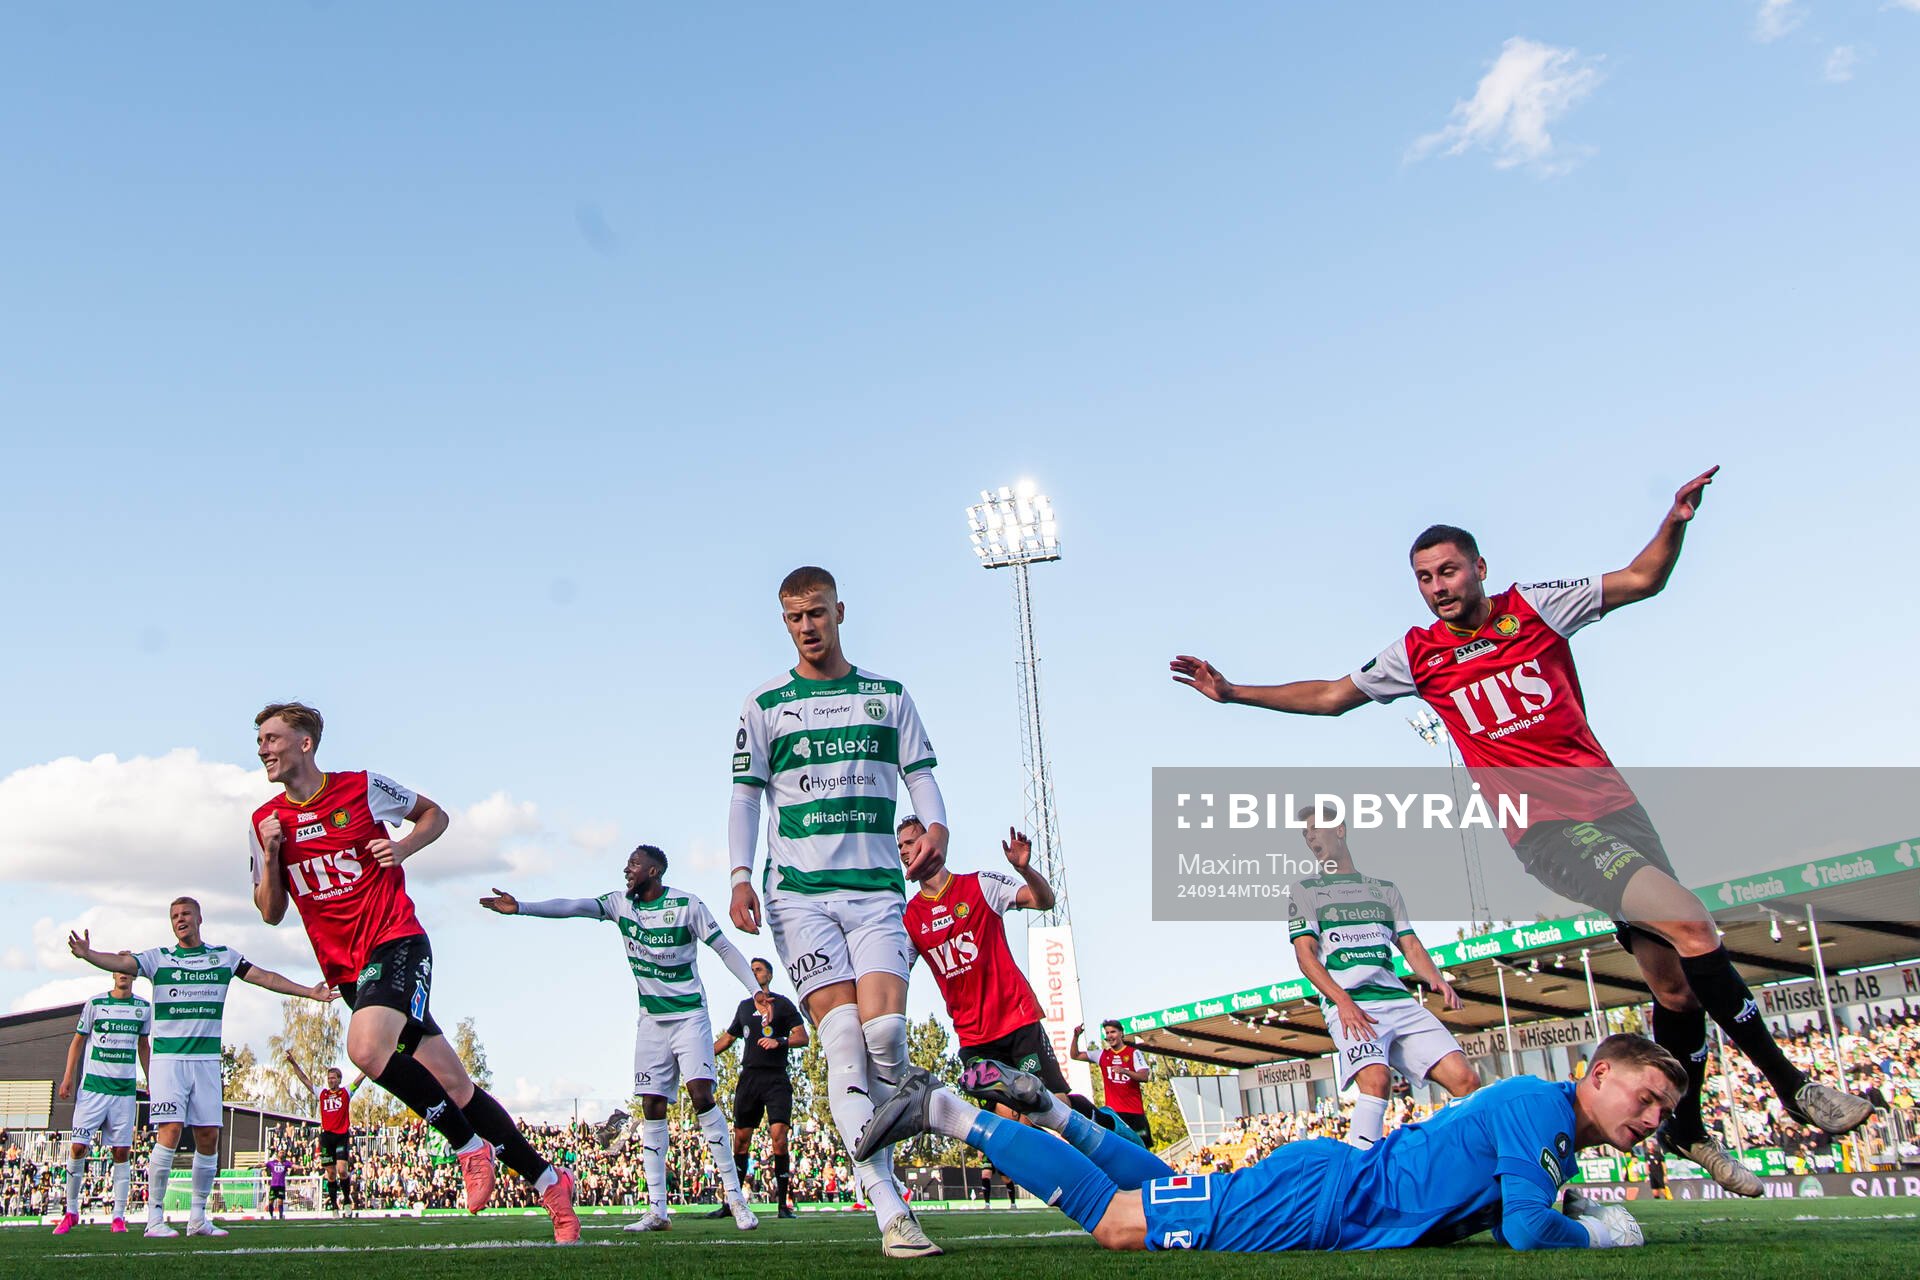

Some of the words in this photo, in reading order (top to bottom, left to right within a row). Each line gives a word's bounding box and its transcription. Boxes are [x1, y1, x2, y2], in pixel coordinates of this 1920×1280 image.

[1456, 638, 1491, 657] SKAB
[780, 690, 797, 698] TAK
[1450, 658, 1553, 735] ITS
[813, 705, 851, 718] Carpenter
[1487, 713, 1546, 740] indeship.se
[813, 735, 879, 757] Telexia
[372, 778, 410, 806] stadium
[850, 810, 878, 823] Enrgy
[297, 825, 323, 837] SKAB
[287, 847, 363, 897] ITS
[1818, 856, 1877, 884] Telexia
[312, 885, 354, 901] indeship.se
[1732, 876, 1786, 902] Telexia
[1340, 907, 1386, 921] Telexia
[638, 930, 674, 945] Telexia
[1523, 925, 1563, 948] Telexia
[928, 930, 979, 975] ITS
[1466, 938, 1502, 959] Telexia
[183, 972, 219, 981] Telexia
[1045, 939, 1065, 1023] Energy
[1773, 979, 1850, 1012] Hisstech
[1856, 975, 1881, 1001] AB
[110, 1022, 138, 1033] Telexia
[1526, 1021, 1581, 1047] Hisstech
[1489, 1033, 1506, 1052] AB
[1263, 1068, 1297, 1085] Hisstech
[1300, 1063, 1312, 1080] AB
[151, 1101, 177, 1113] RYDS
[323, 1097, 343, 1111] ITS
